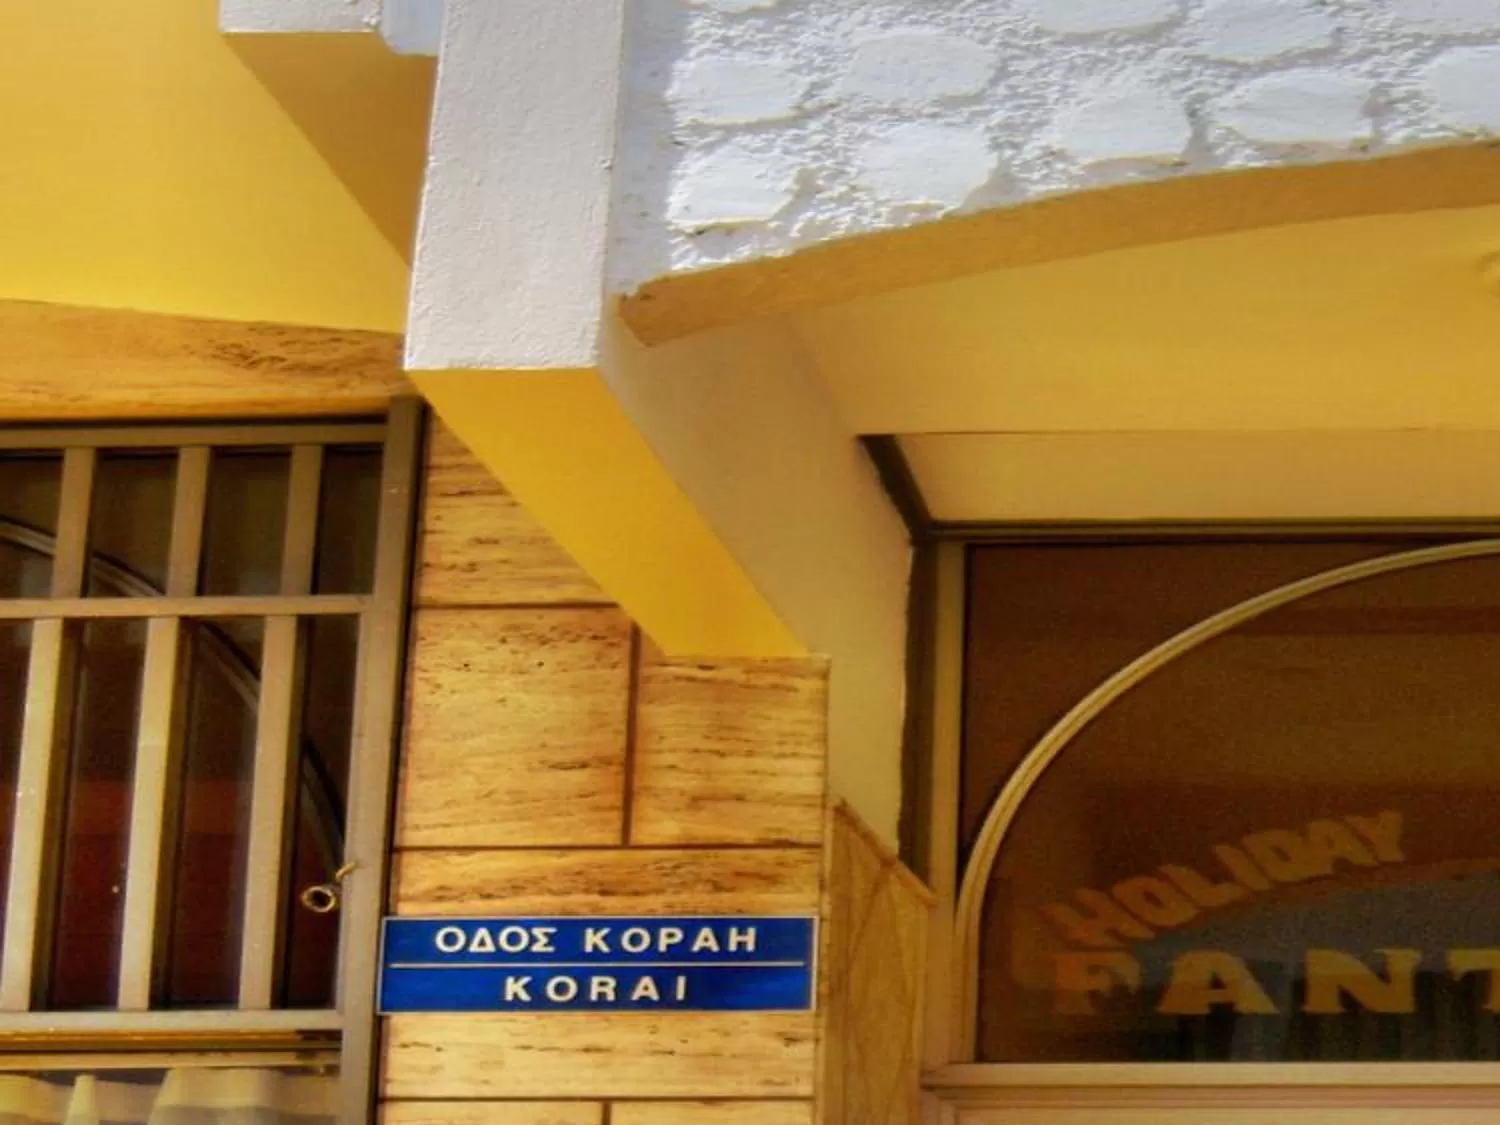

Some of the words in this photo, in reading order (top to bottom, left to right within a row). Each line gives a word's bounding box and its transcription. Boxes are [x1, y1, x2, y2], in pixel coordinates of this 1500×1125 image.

[1041, 809, 1406, 946] HOLIDAY
[435, 926, 557, 953] ΟΔΟΣ
[583, 926, 757, 953] ΚΟΡΑΗ
[504, 975, 687, 1003] KORAI
